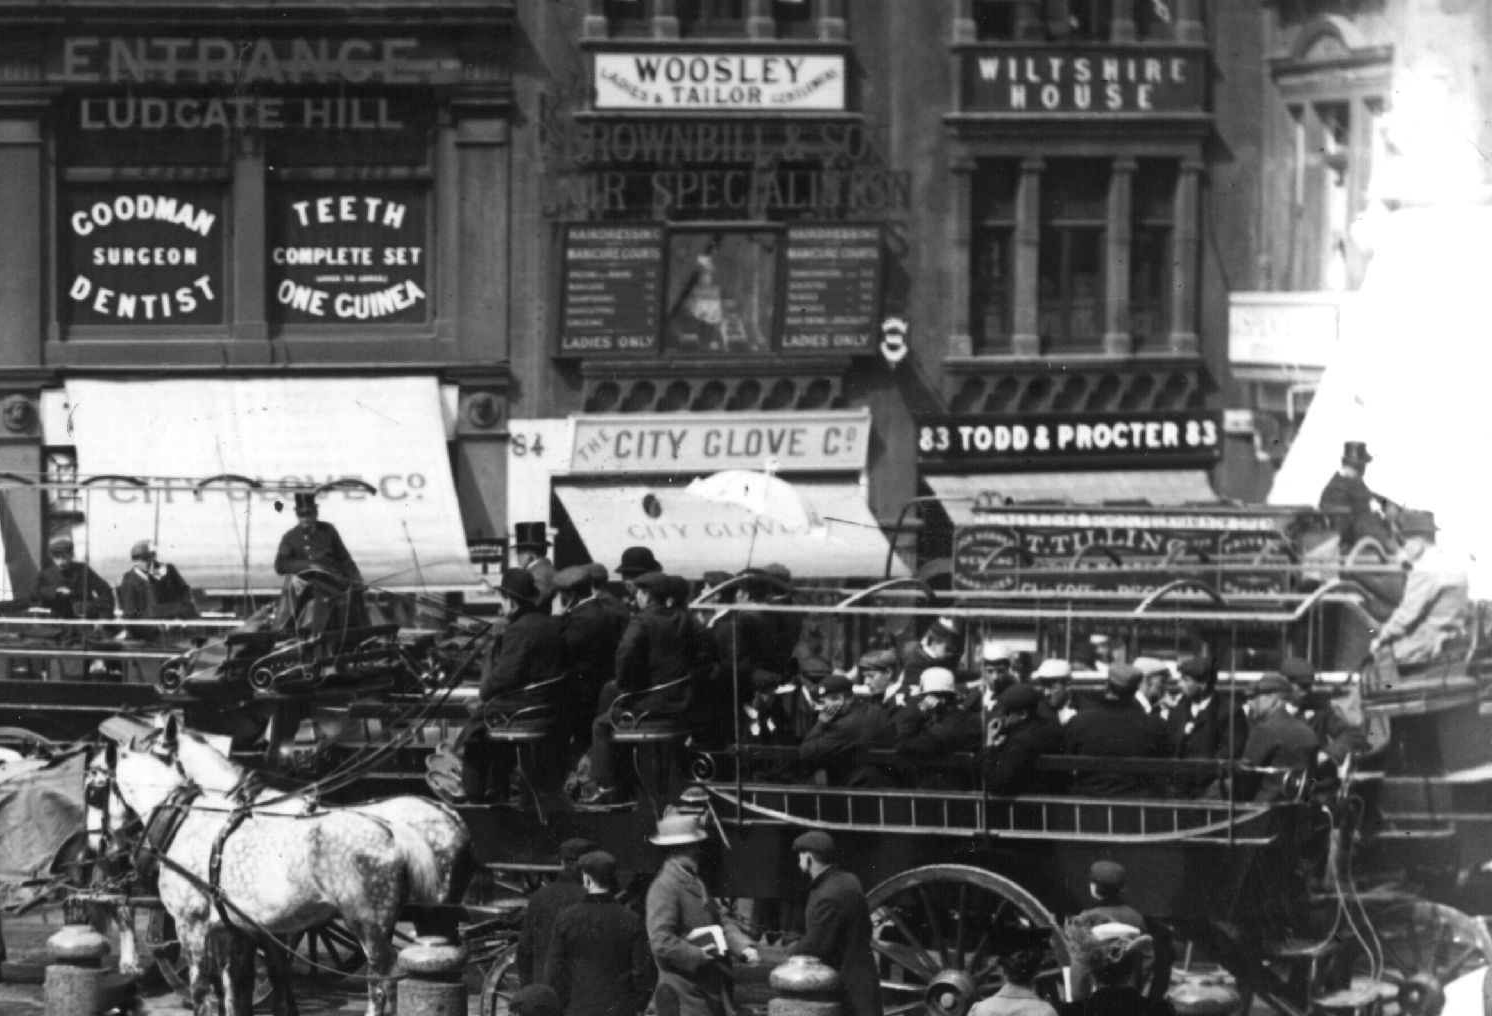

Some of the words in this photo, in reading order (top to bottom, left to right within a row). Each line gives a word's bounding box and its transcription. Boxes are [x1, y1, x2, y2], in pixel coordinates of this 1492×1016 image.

[63, 37, 420, 85] ENTRANCE
[634, 57, 805, 83] WOOSLEY
[978, 57, 1187, 82] WILTSHIRE
[670, 86, 762, 105] TAILOR
[1010, 83, 1153, 111] HOUSE
[80, 98, 285, 129] LUDGATE
[302, 98, 404, 129] HILL
[71, 195, 216, 237] GOODMAN
[292, 196, 407, 230] TEETH
[93, 247, 198, 267] SURGEON
[273, 247, 374, 266] COMPLETE
[383, 247, 422, 266] SET
[69, 275, 215, 319] DENTIST
[278, 279, 325, 317] ONE
[333, 278, 426, 320] GUINEA
[562, 335, 613, 350] LADIES
[511, 433, 545, 457] 84
[577, 428, 612, 461] THE
[614, 429, 689, 461] CITY
[702, 426, 808, 458] GLOVE
[919, 426, 951, 452] 83
[958, 425, 1031, 452] TODD
[1033, 425, 1051, 451] &
[1057, 421, 1180, 449] PROCTER
[1185, 419, 1218, 446] 83
[627, 521, 688, 540] CITY
